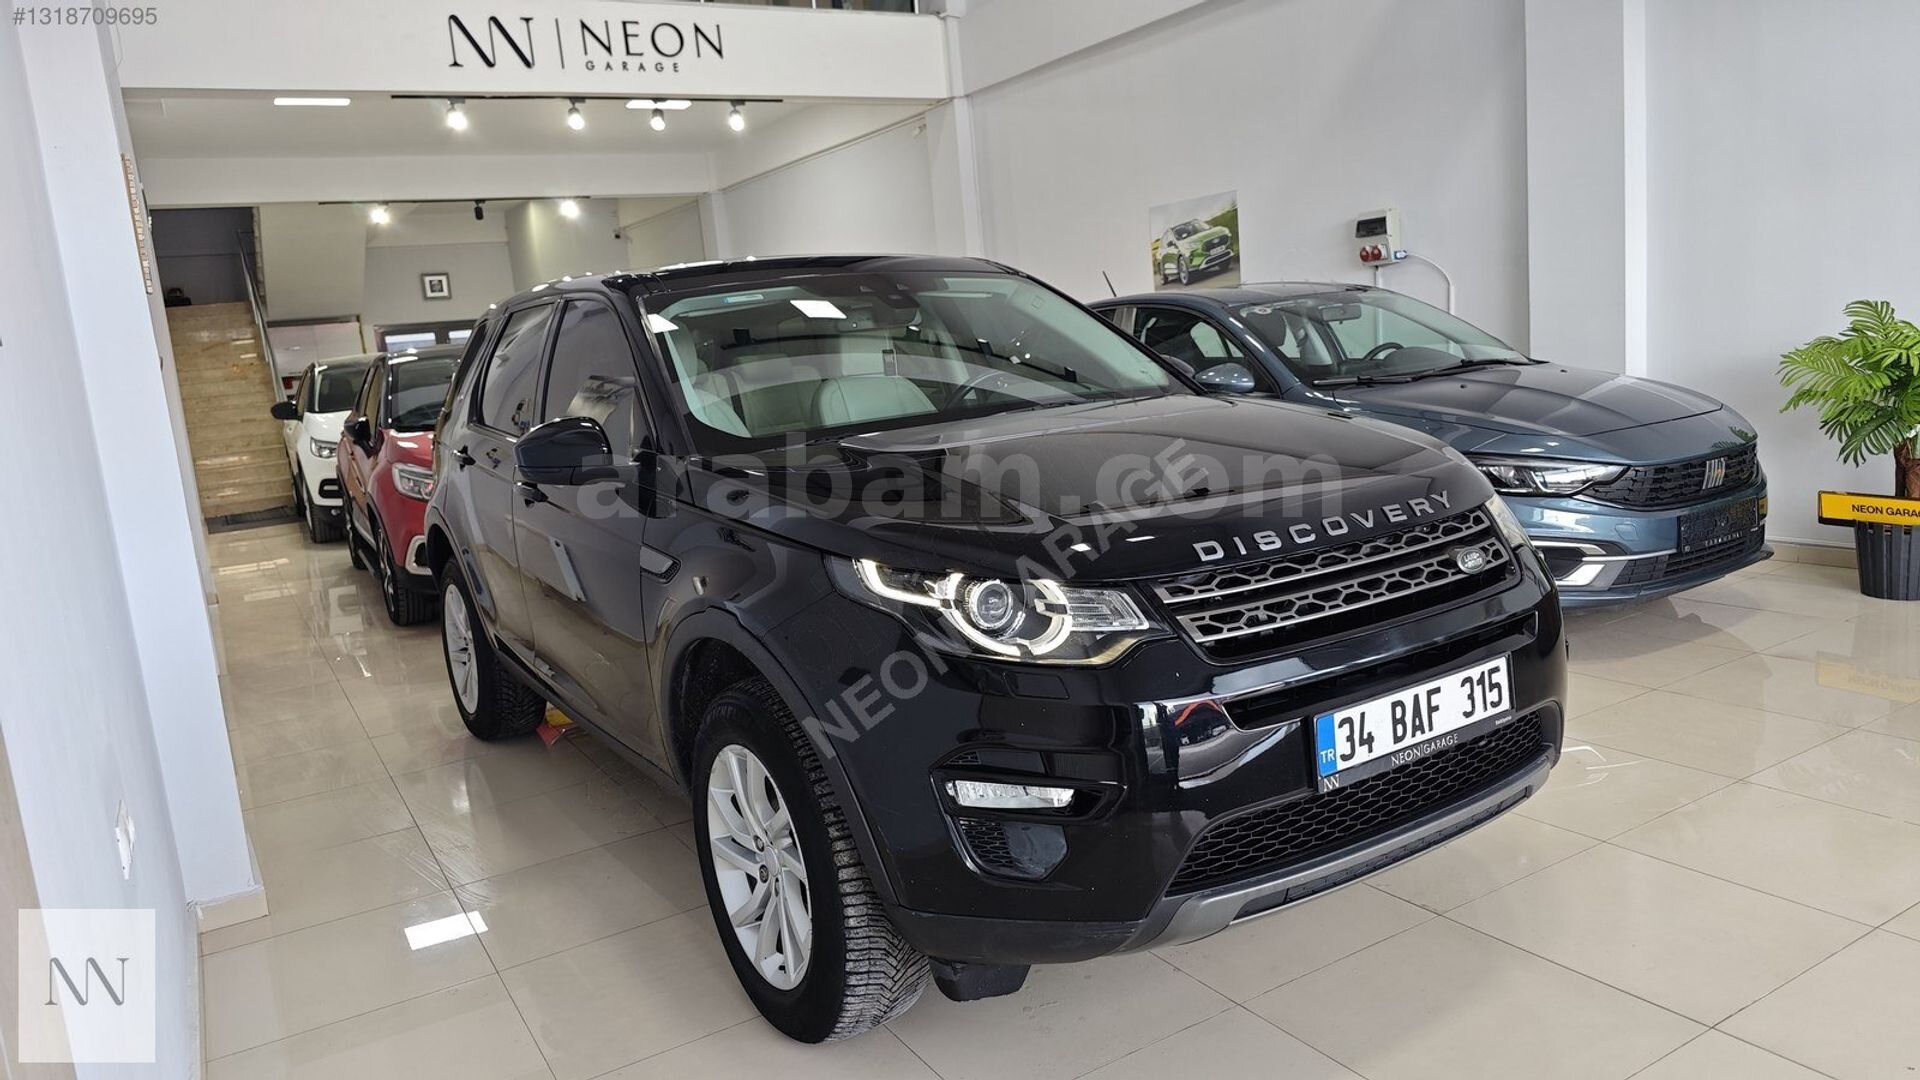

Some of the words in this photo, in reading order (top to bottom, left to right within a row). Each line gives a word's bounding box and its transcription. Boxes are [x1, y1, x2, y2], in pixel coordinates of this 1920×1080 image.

[580, 19, 723, 59] NEON
[585, 61, 679, 73] GARAGE
[1851, 503, 1884, 515] NEON
[1192, 490, 1451, 562] DISCOVERY
[1337, 711, 1375, 762] 34
[1390, 686, 1441, 745] BAF
[1460, 665, 1502, 719] 315
[1423, 733, 1458, 754] GARAGE
[1320, 748, 1335, 764] TR
